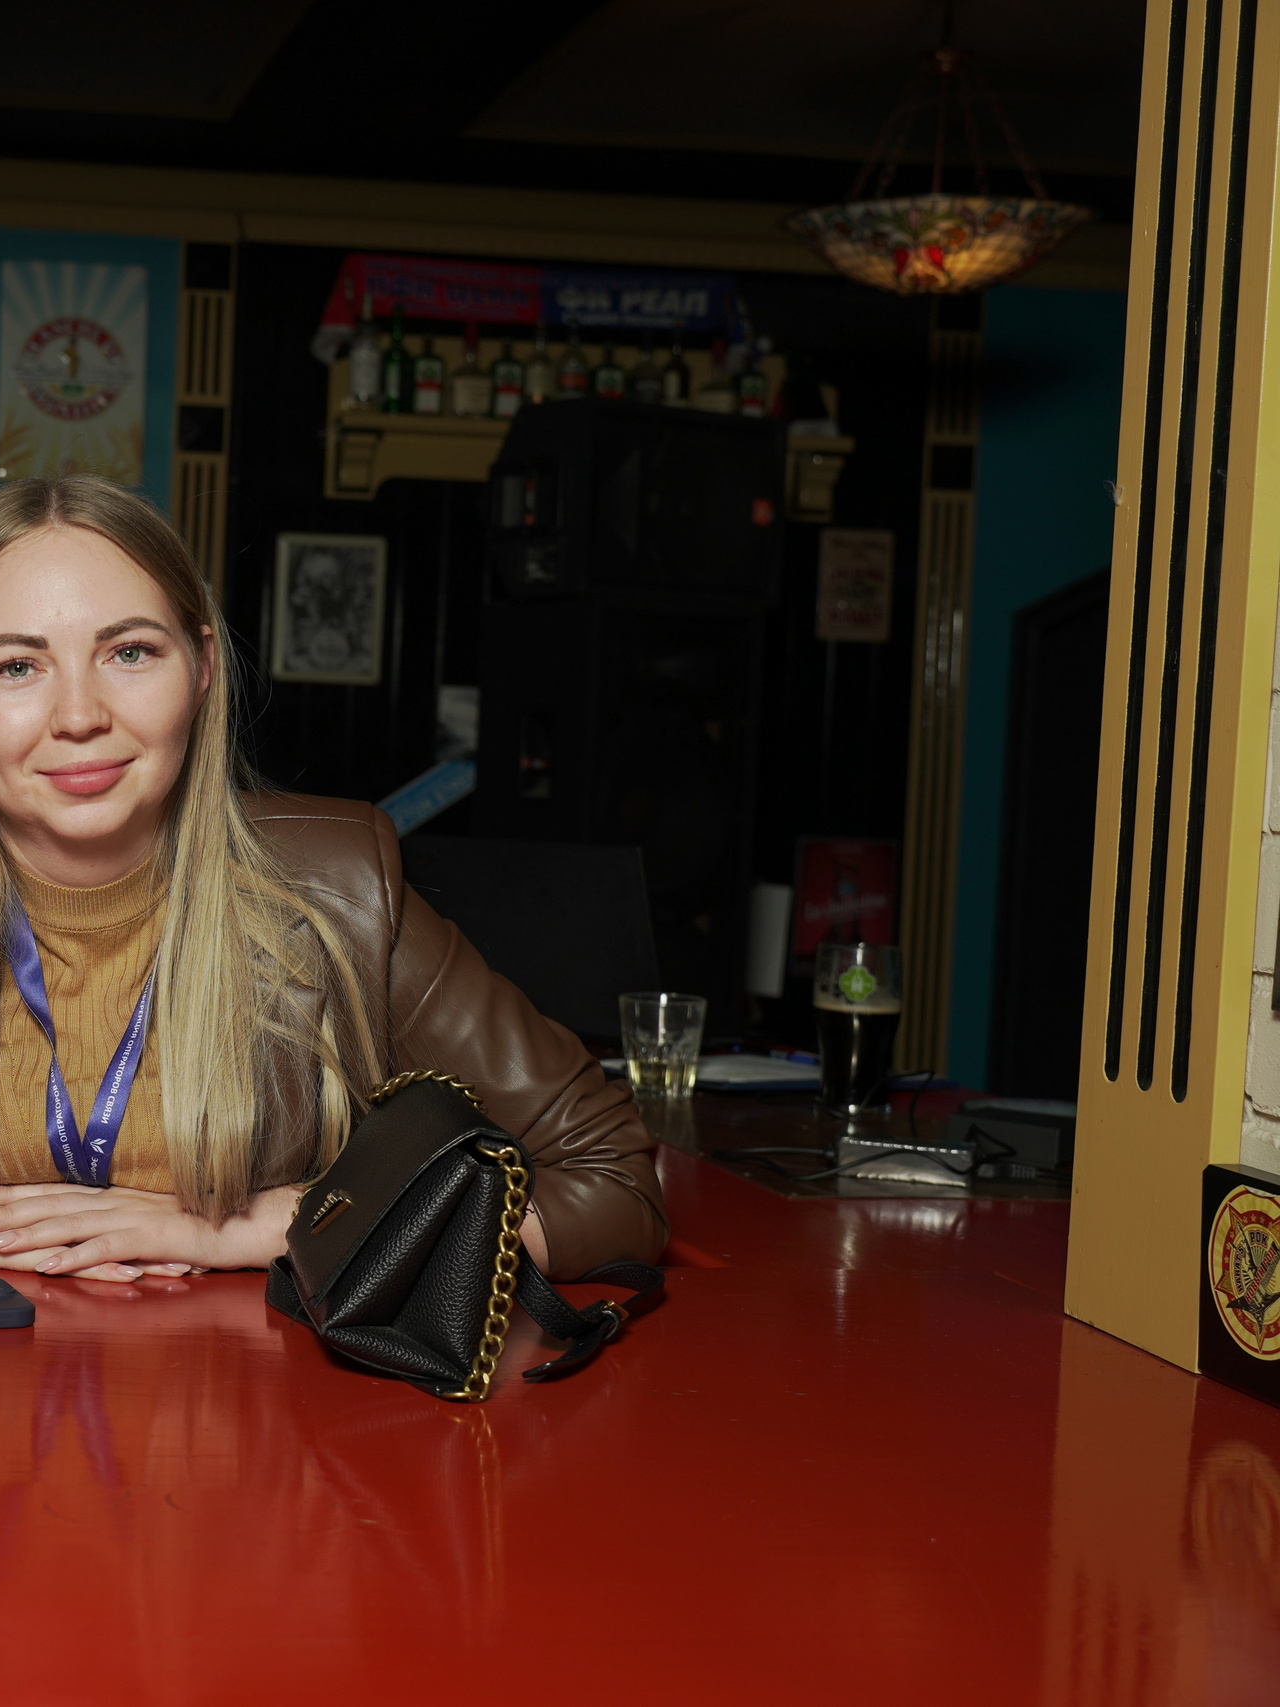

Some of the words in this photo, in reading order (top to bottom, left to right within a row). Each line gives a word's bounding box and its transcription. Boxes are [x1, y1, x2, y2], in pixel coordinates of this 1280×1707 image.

[110, 1040, 134, 1095] ОПЕРАТОРОВ
[52, 1084, 68, 1142] ОПЕРАТОРОВ
[101, 1094, 116, 1125] СВЯЗИ
[1249, 1230, 1269, 1248] РОК
